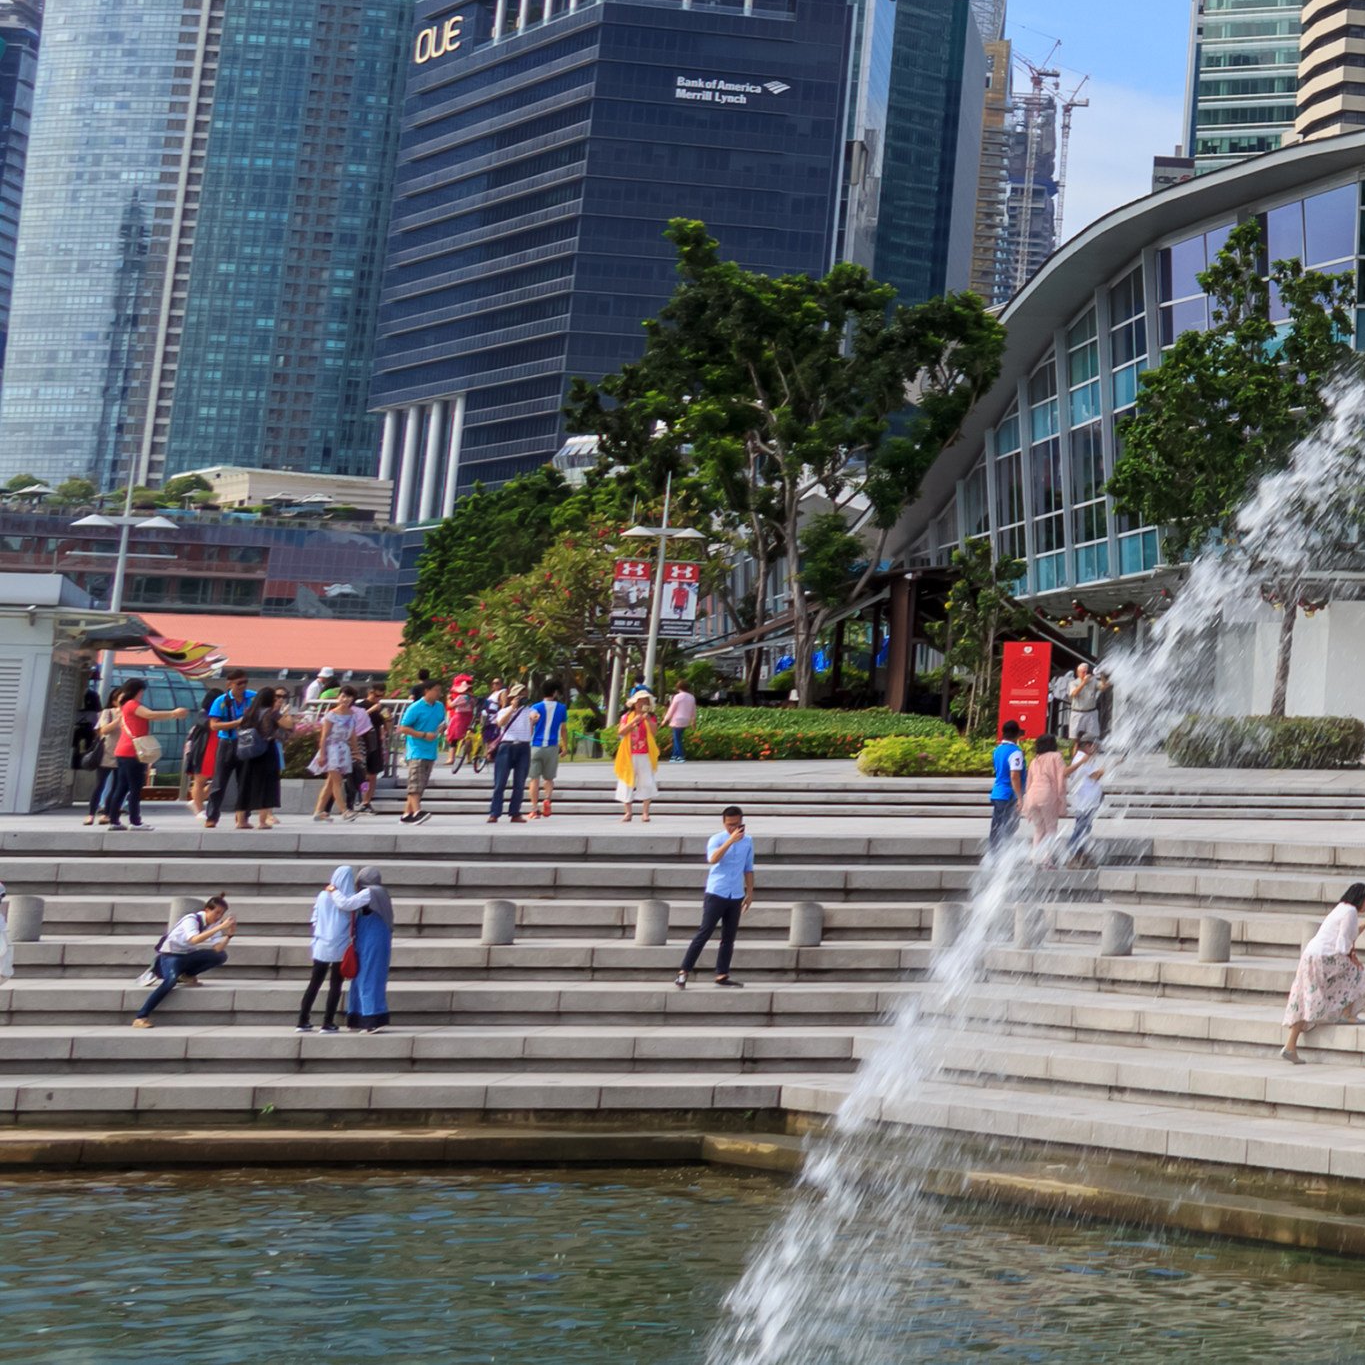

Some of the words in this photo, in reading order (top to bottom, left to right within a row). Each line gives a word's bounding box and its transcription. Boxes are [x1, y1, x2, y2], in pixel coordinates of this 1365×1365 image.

[415, 15, 463, 64] OUE
[676, 76, 704, 88] Bank
[705, 80, 717, 89] of
[717, 80, 762, 94] America
[675, 88, 712, 101] Merrill
[714, 92, 747, 104] Lynch
